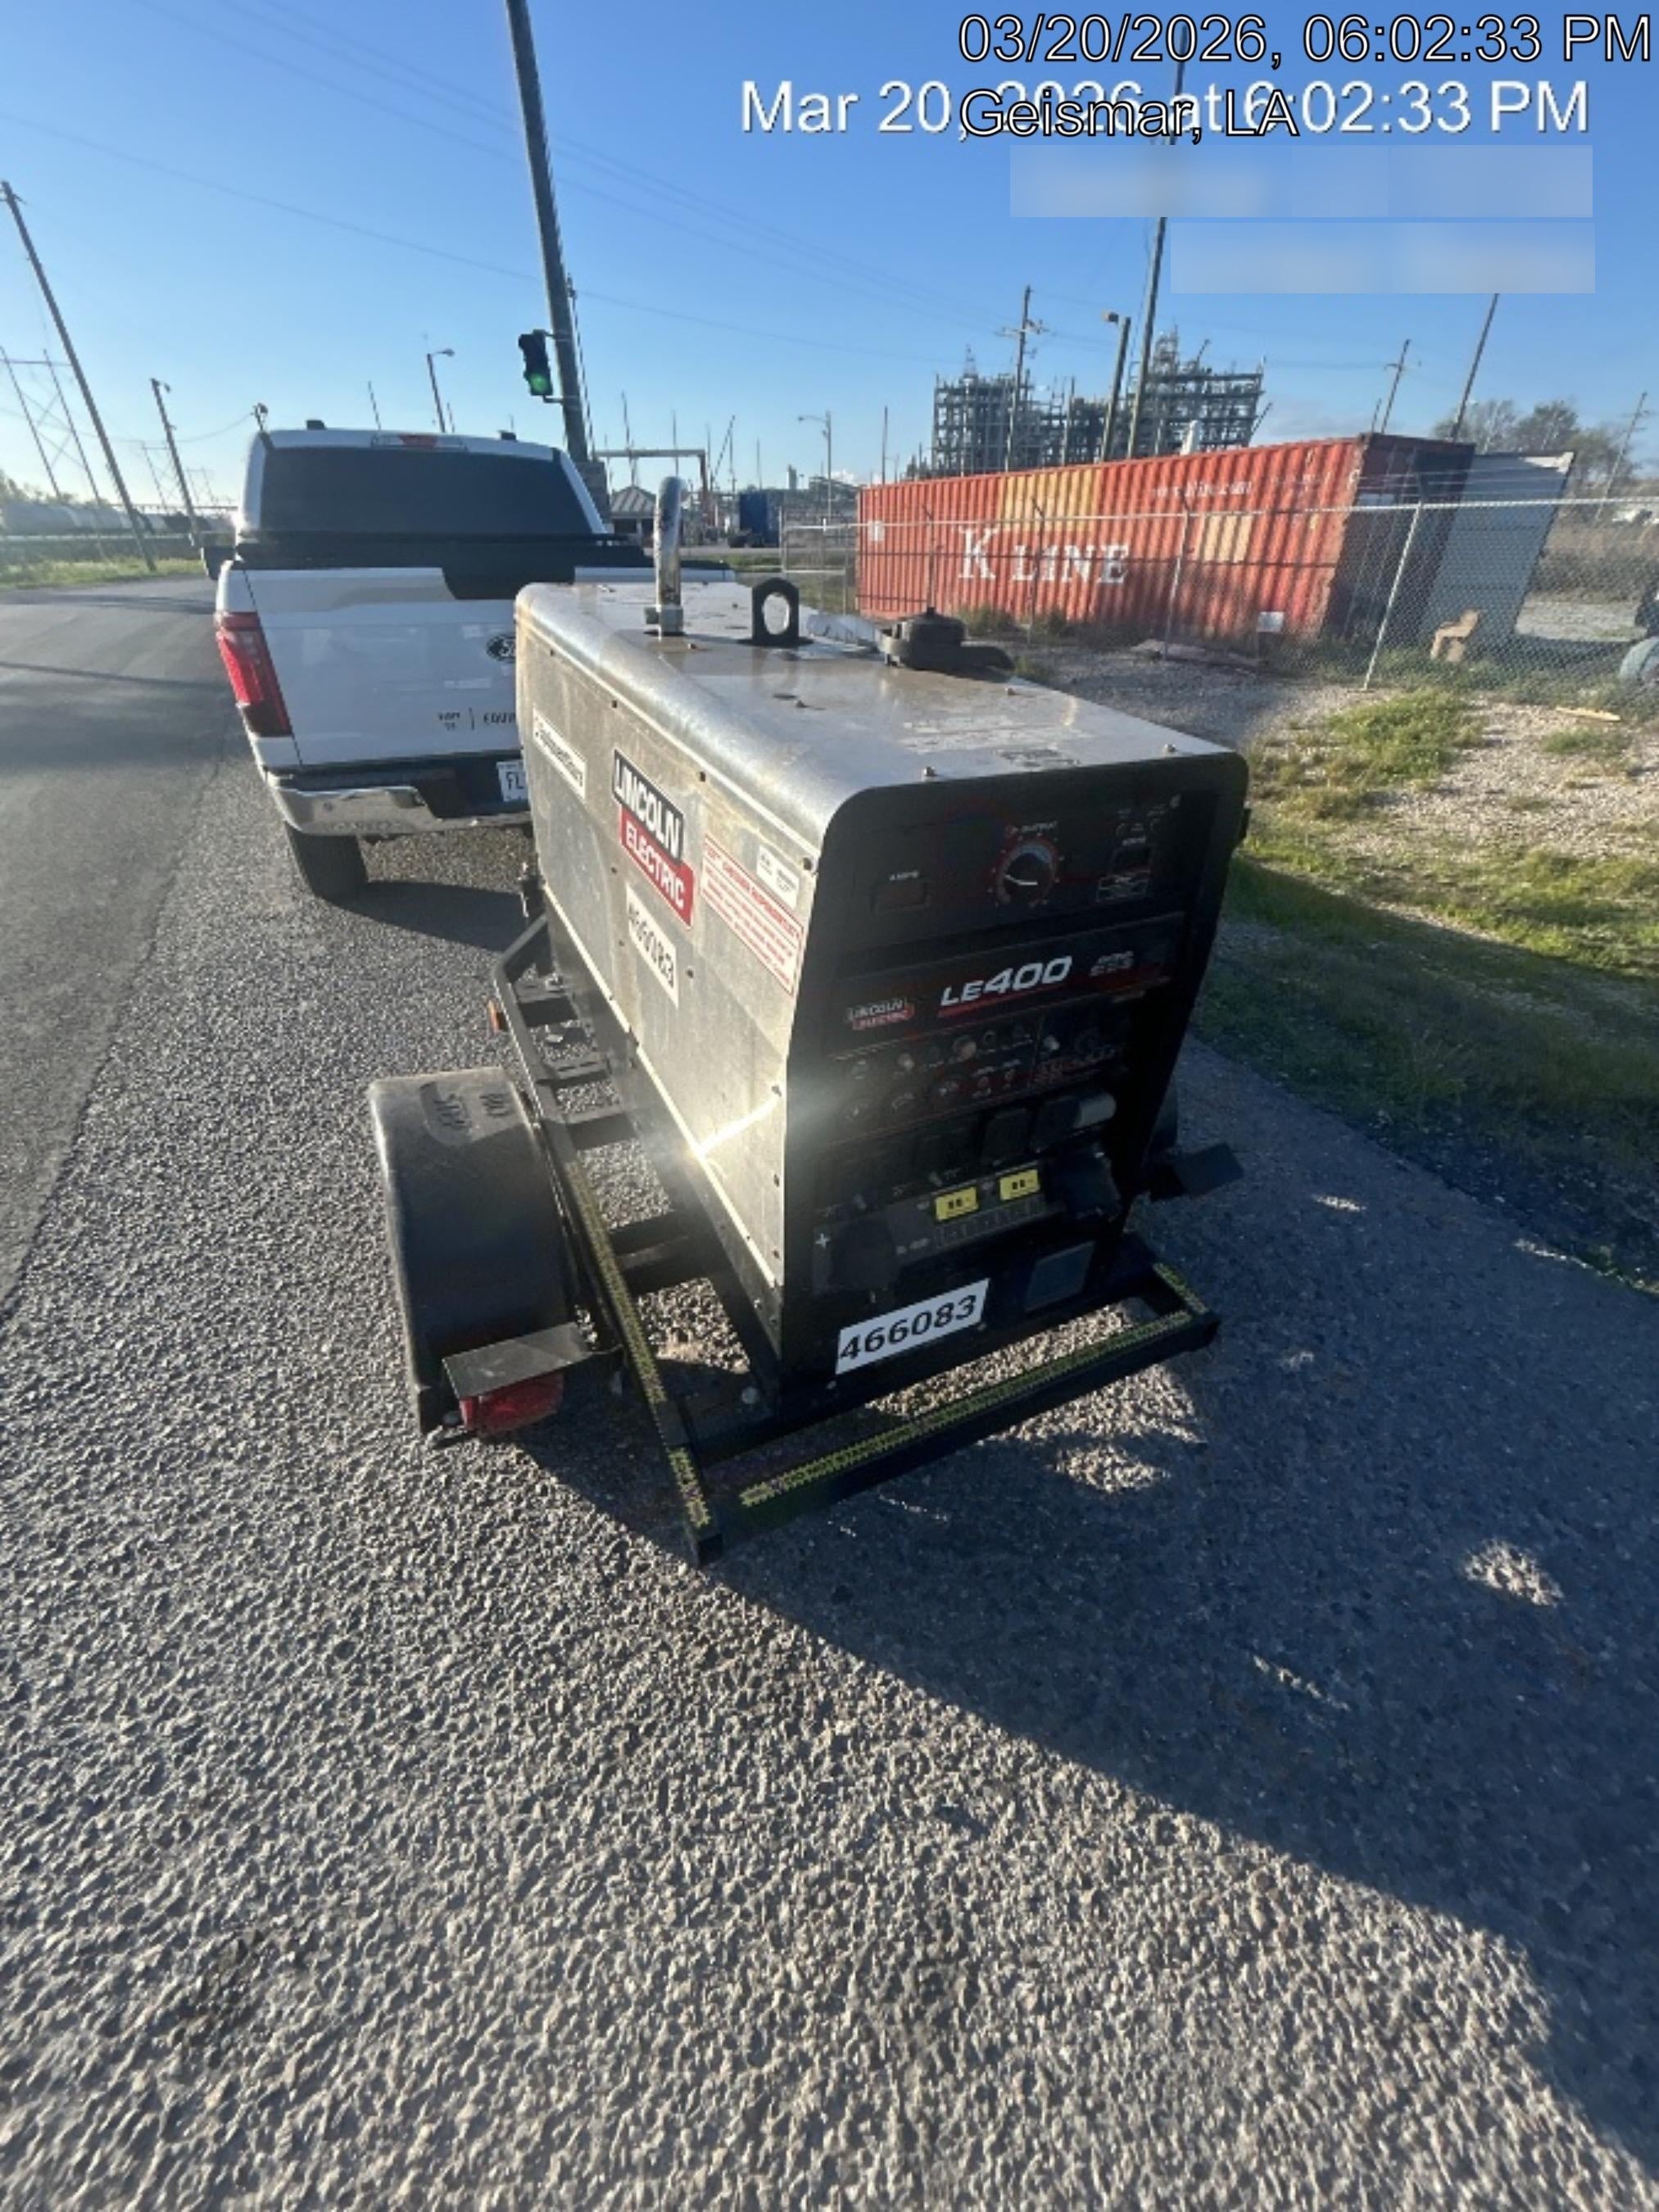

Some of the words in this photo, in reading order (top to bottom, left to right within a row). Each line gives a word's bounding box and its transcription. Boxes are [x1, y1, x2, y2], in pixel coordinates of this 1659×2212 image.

[959, 525, 999, 580] K
[1012, 543, 1130, 583] LINE
[615, 757, 681, 860] LINCOLN
[626, 819, 685, 909] ELECTRIC
[941, 955, 1072, 1007] LE400
[839, 1294, 977, 1360] 466083
